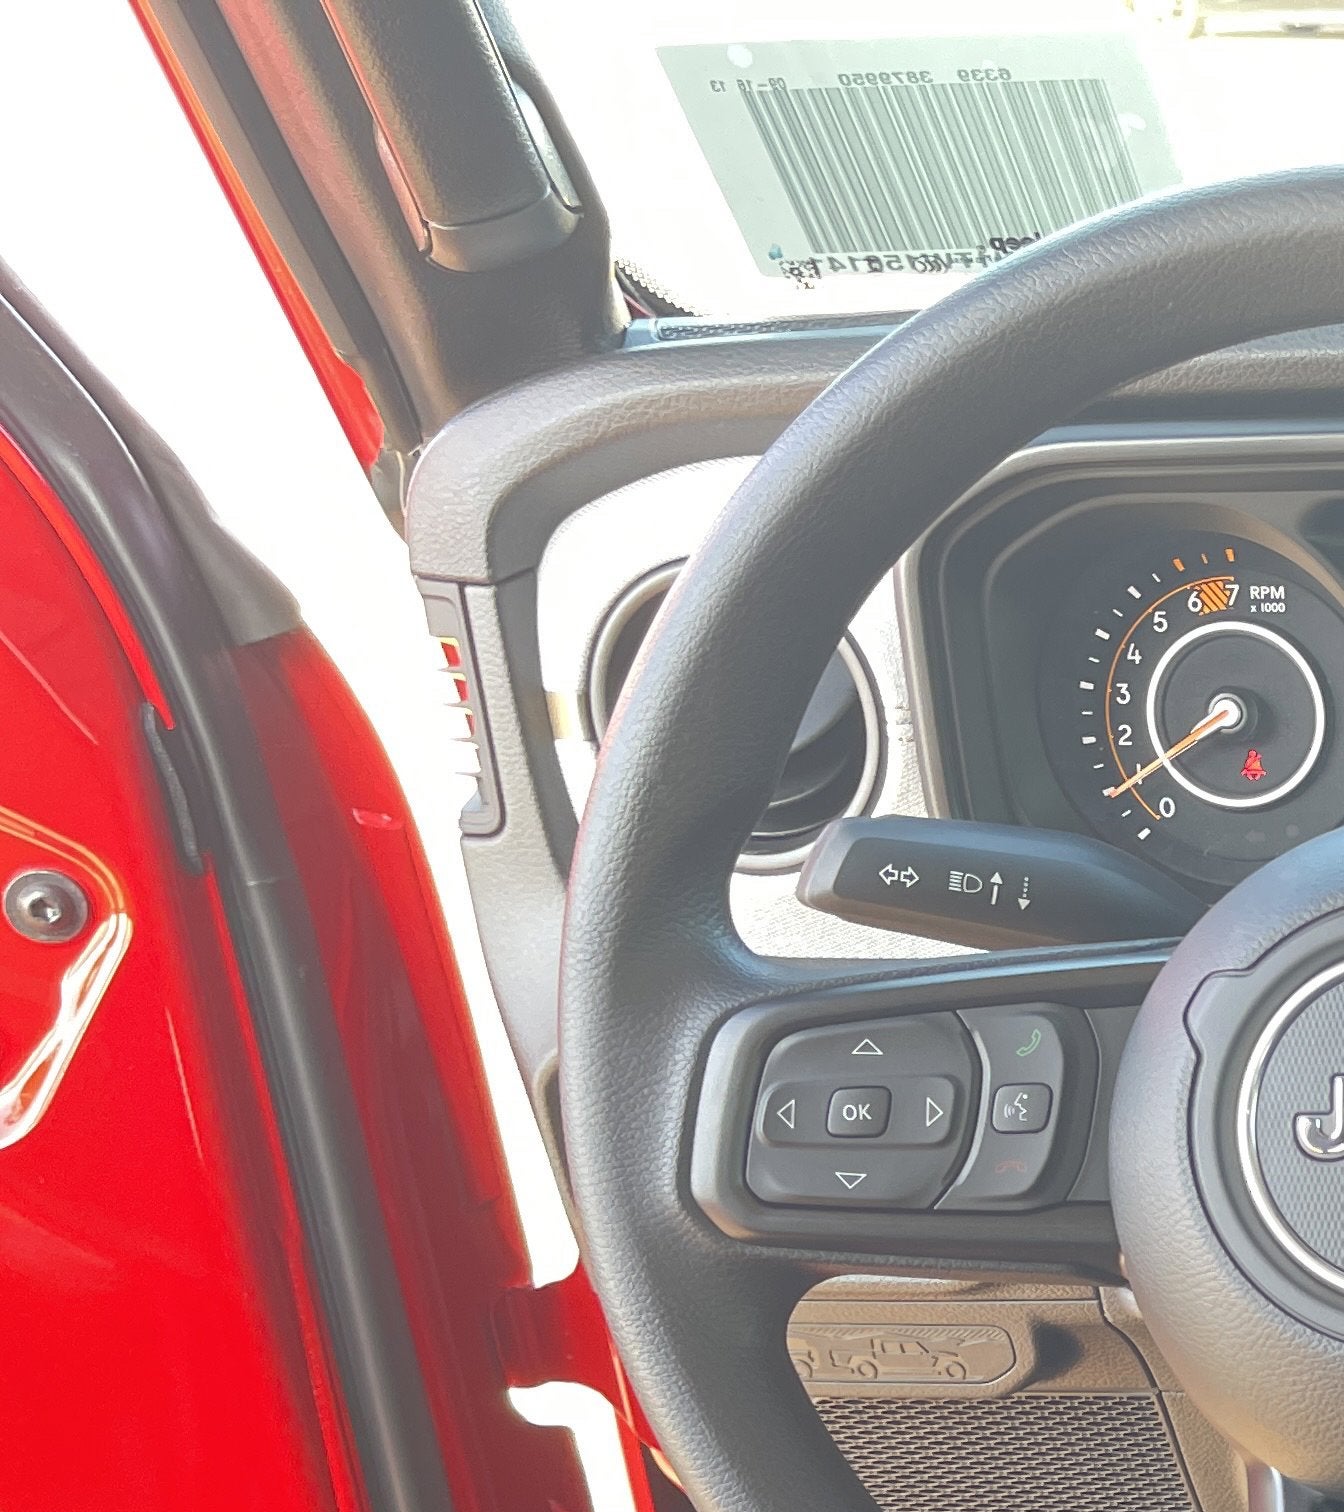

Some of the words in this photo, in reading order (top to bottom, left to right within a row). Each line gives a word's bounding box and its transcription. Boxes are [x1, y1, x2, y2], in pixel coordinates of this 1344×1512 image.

[1187, 590, 1202, 612] 6
[1224, 584, 1240, 607] 7
[1250, 586, 1286, 600] RPM
[1260, 602, 1286, 613] 1000
[1152, 611, 1168, 633] 5
[1126, 643, 1143, 664] 4
[1115, 682, 1132, 705] 3
[1118, 724, 1133, 746] 2
[1159, 797, 1176, 818] 0
[842, 1103, 873, 1122] OK
